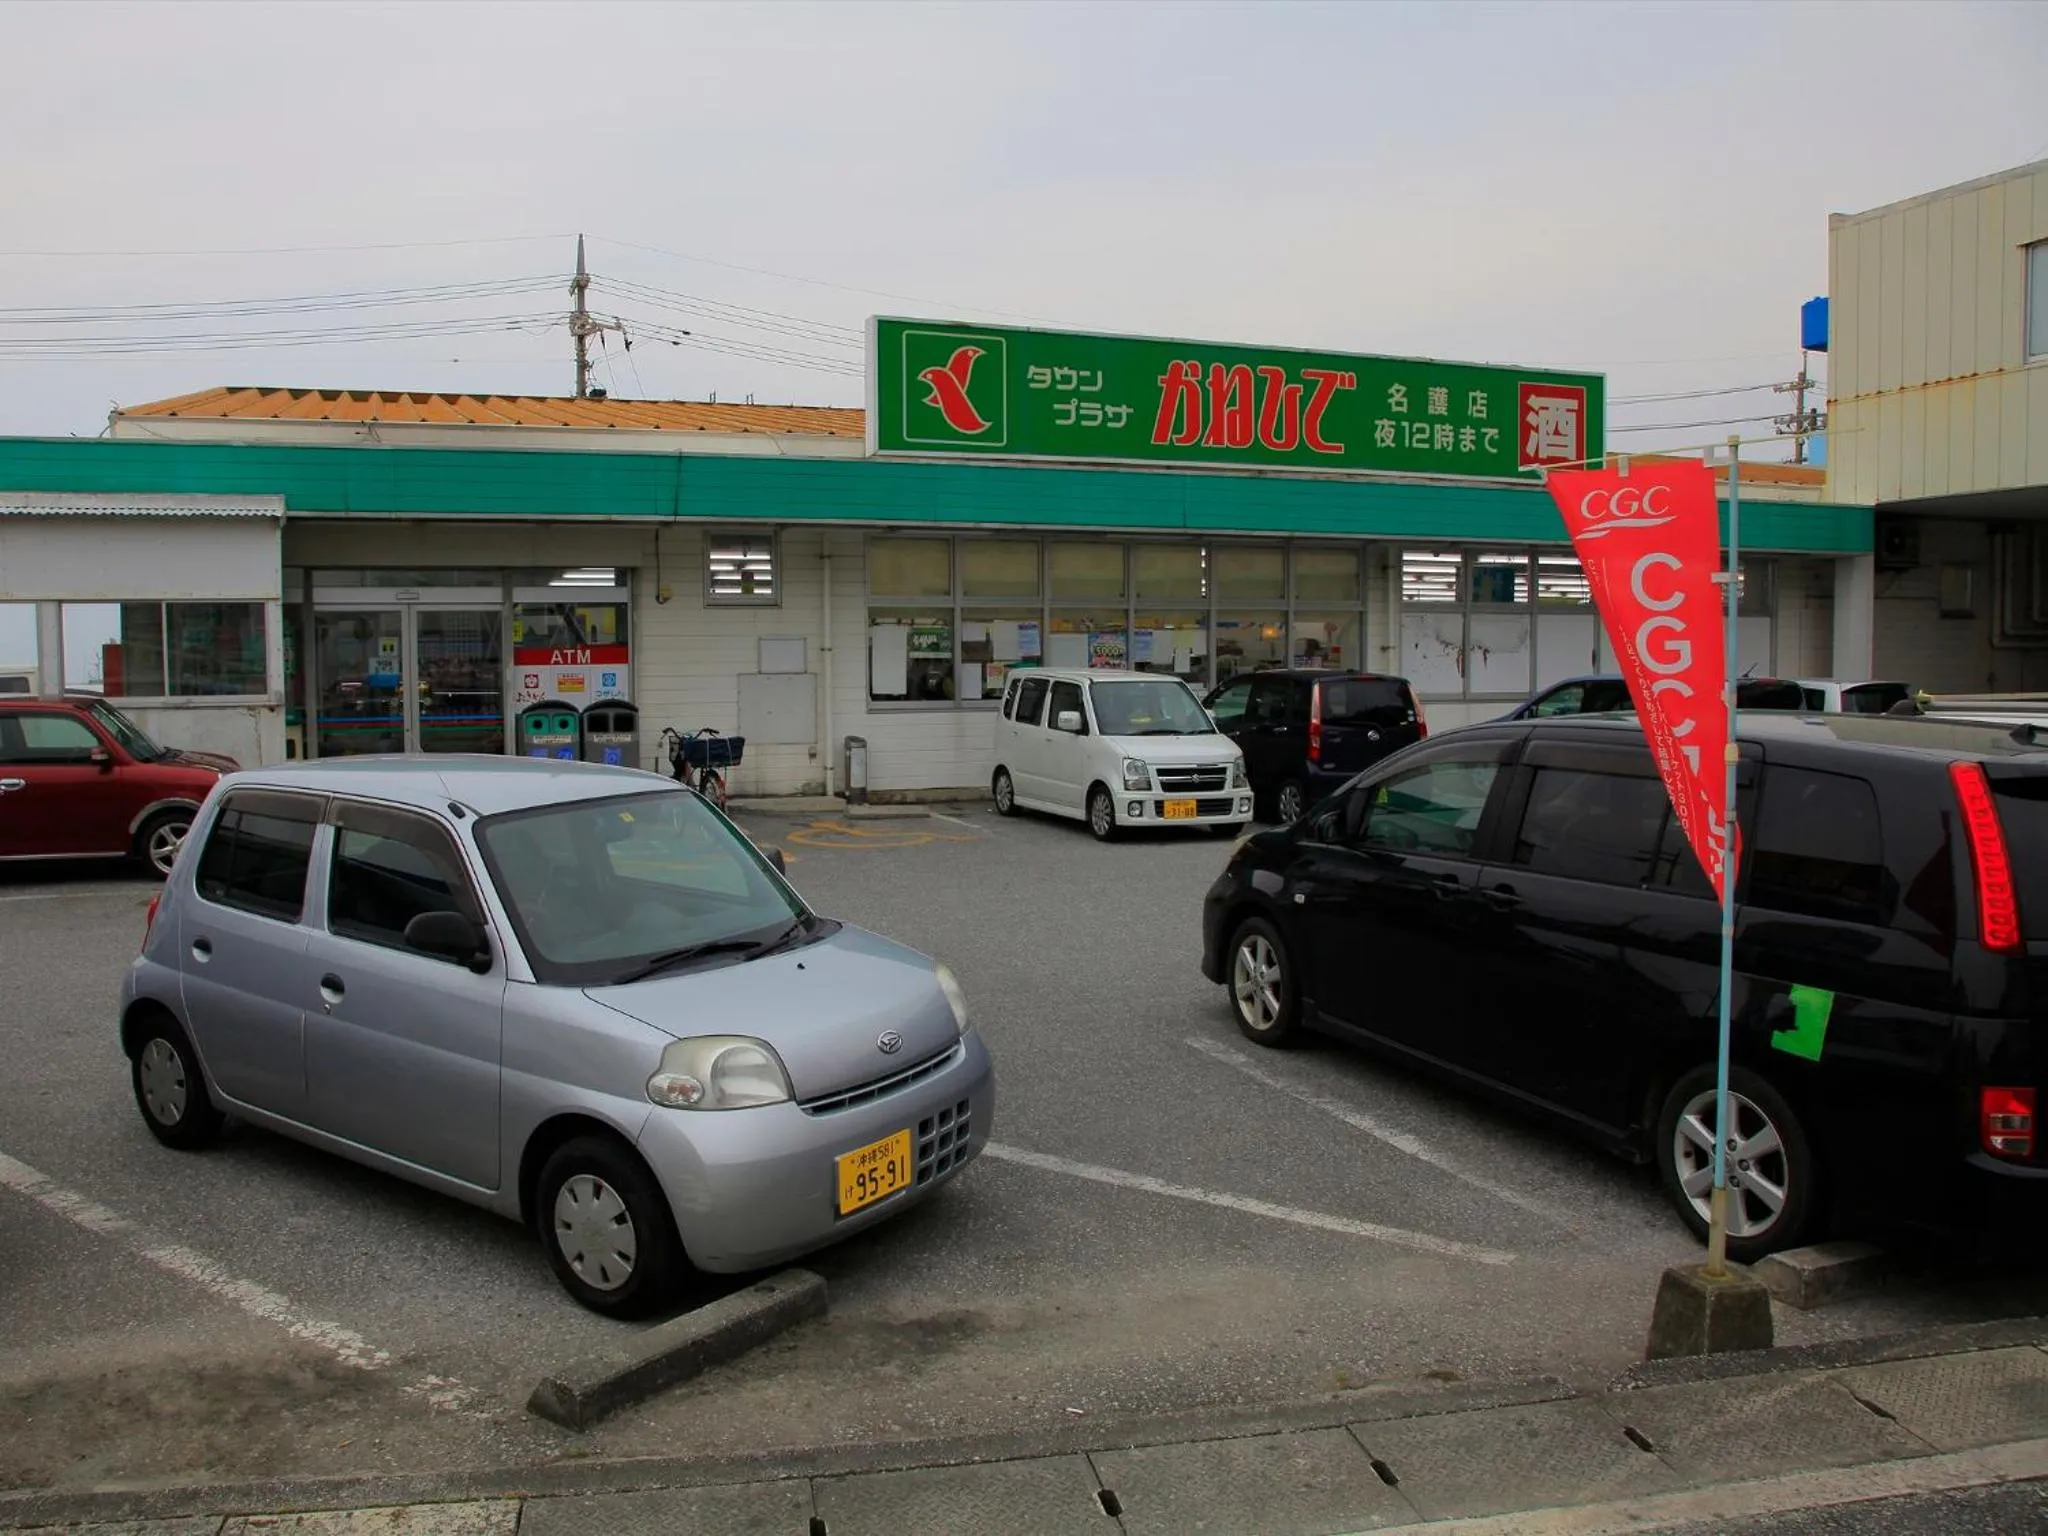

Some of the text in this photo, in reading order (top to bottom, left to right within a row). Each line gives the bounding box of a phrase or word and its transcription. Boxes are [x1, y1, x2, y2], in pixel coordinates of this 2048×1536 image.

[1027, 364, 1103, 392] タウン
[1151, 359, 1357, 454] かねひで
[1387, 382, 1488, 420] 名護店
[1374, 417, 1500, 454] 夜12時まで
[1526, 393, 1579, 461] 酒
[1580, 485, 1672, 520] CGC
[551, 649, 591, 665] ATM
[856, 1155, 904, 1201] 95-91
